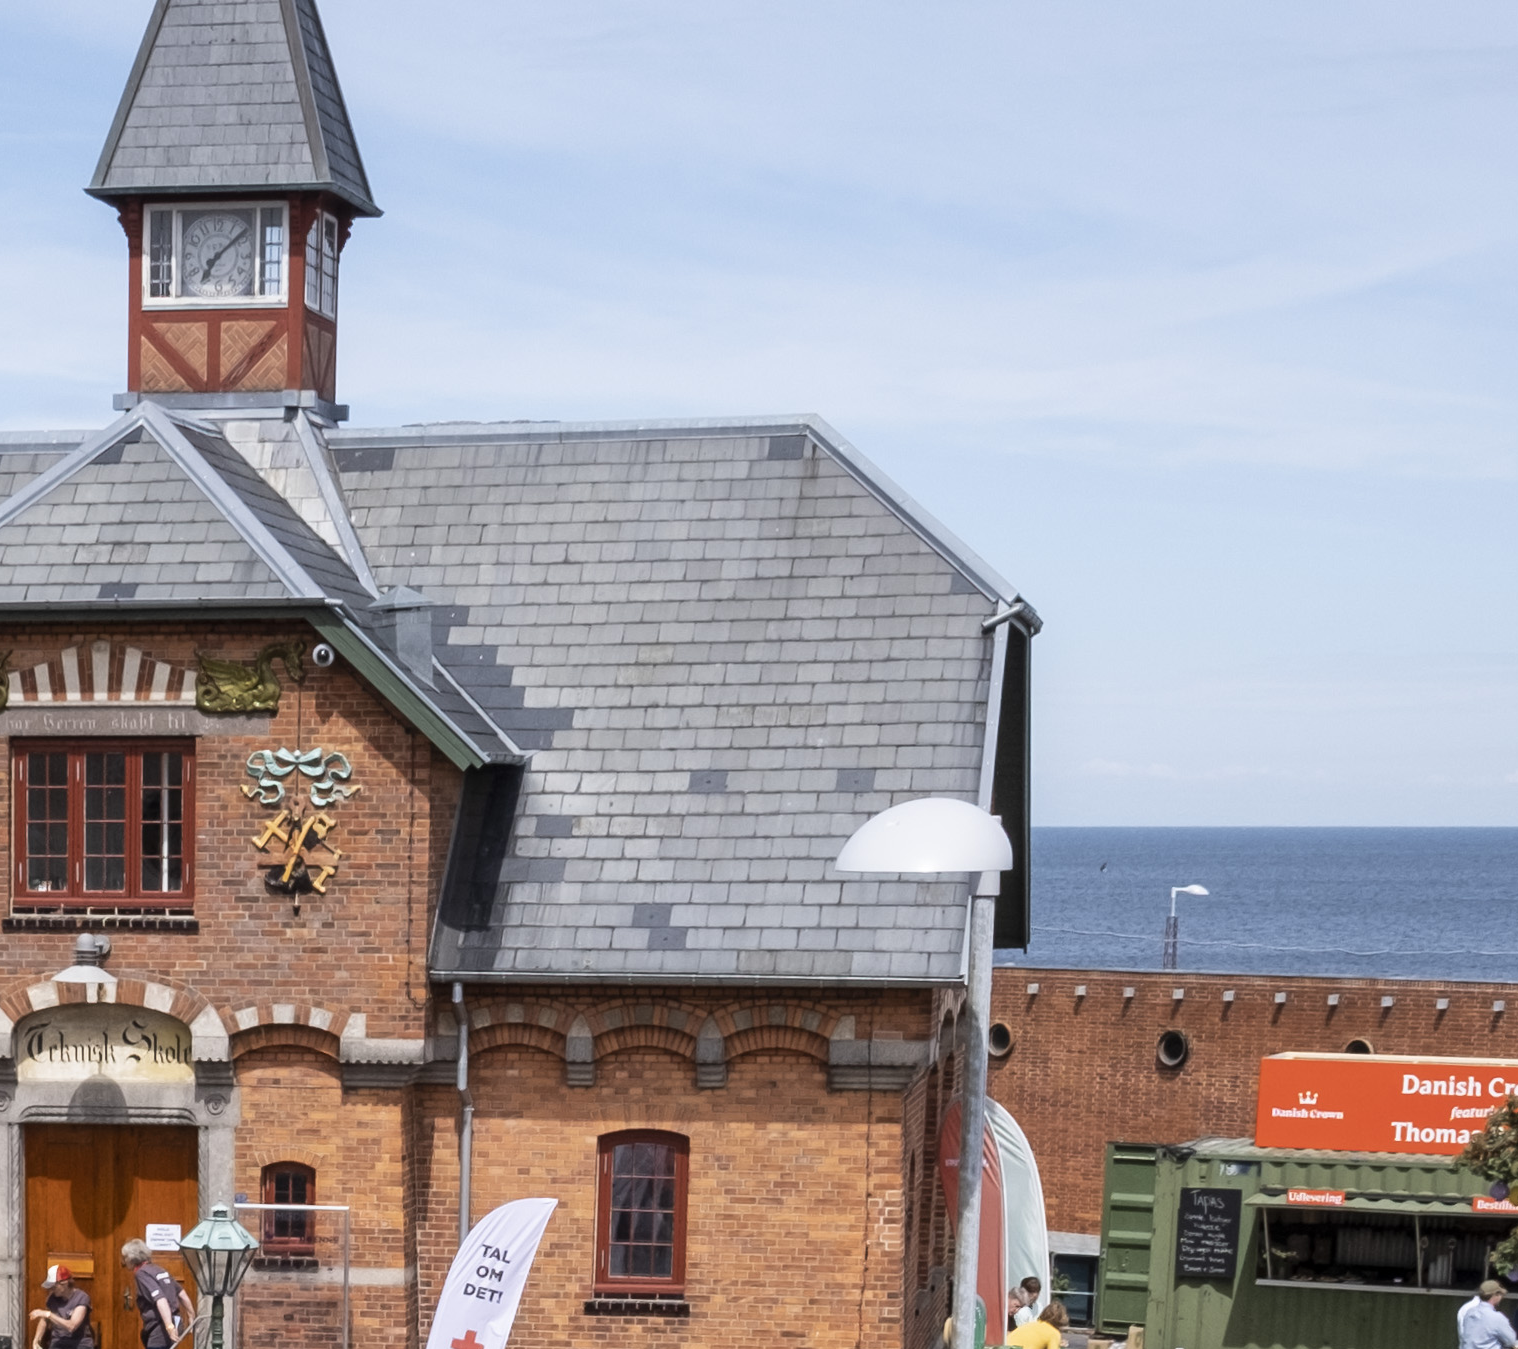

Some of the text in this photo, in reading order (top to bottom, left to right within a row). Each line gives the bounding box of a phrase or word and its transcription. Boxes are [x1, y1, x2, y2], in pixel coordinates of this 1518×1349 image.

[168, 714, 186, 730] til
[24, 1020, 192, 1064] Teknisk Skole
[1401, 1074, 1482, 1097] Danish
[1271, 1106, 1344, 1121] Danish Crown
[1450, 1105, 1495, 1121] featuri
[1391, 1121, 1482, 1144] Thoma
[1288, 1191, 1343, 1205] Udlevering
[481, 1244, 511, 1264] TAL
[476, 1265, 504, 1283] OM
[462, 1284, 504, 1304] DET!
